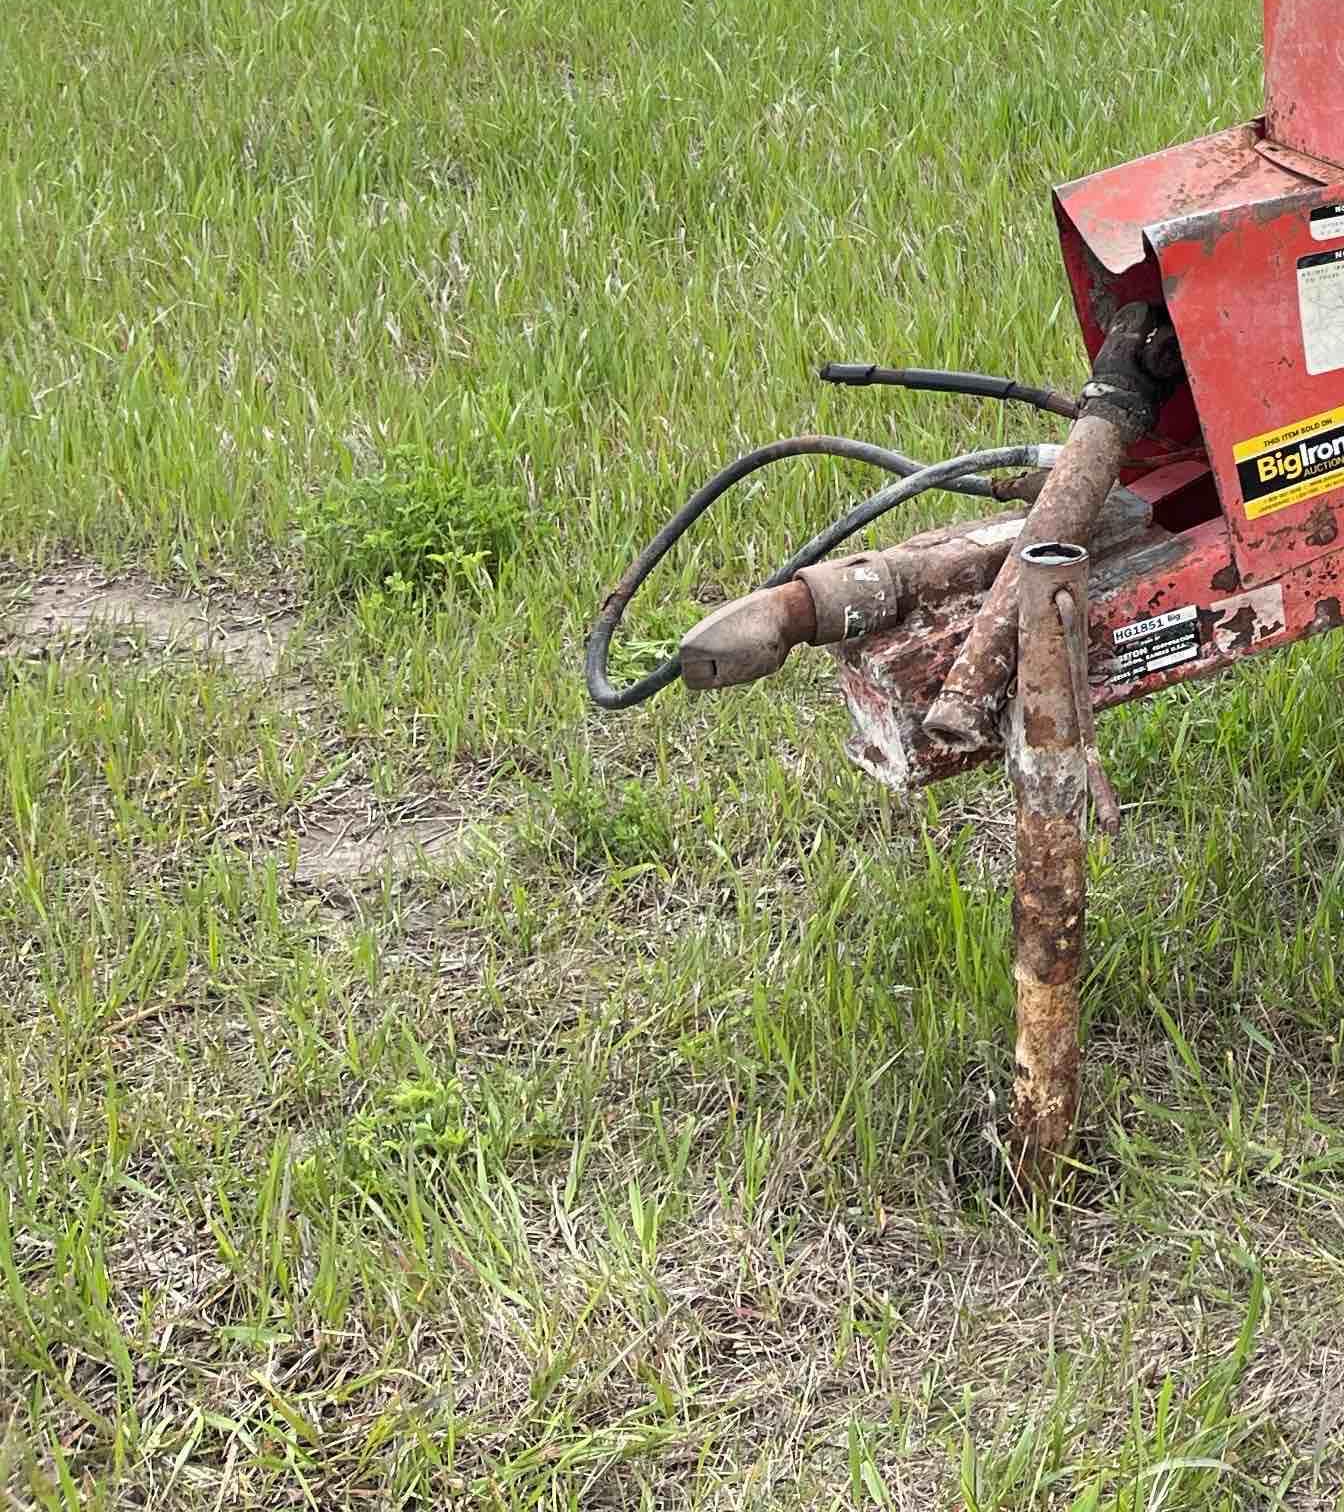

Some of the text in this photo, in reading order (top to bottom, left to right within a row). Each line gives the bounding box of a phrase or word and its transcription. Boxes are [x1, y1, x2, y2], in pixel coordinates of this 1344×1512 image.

[1264, 418, 1333, 447] THIS ITEM SOLD ON
